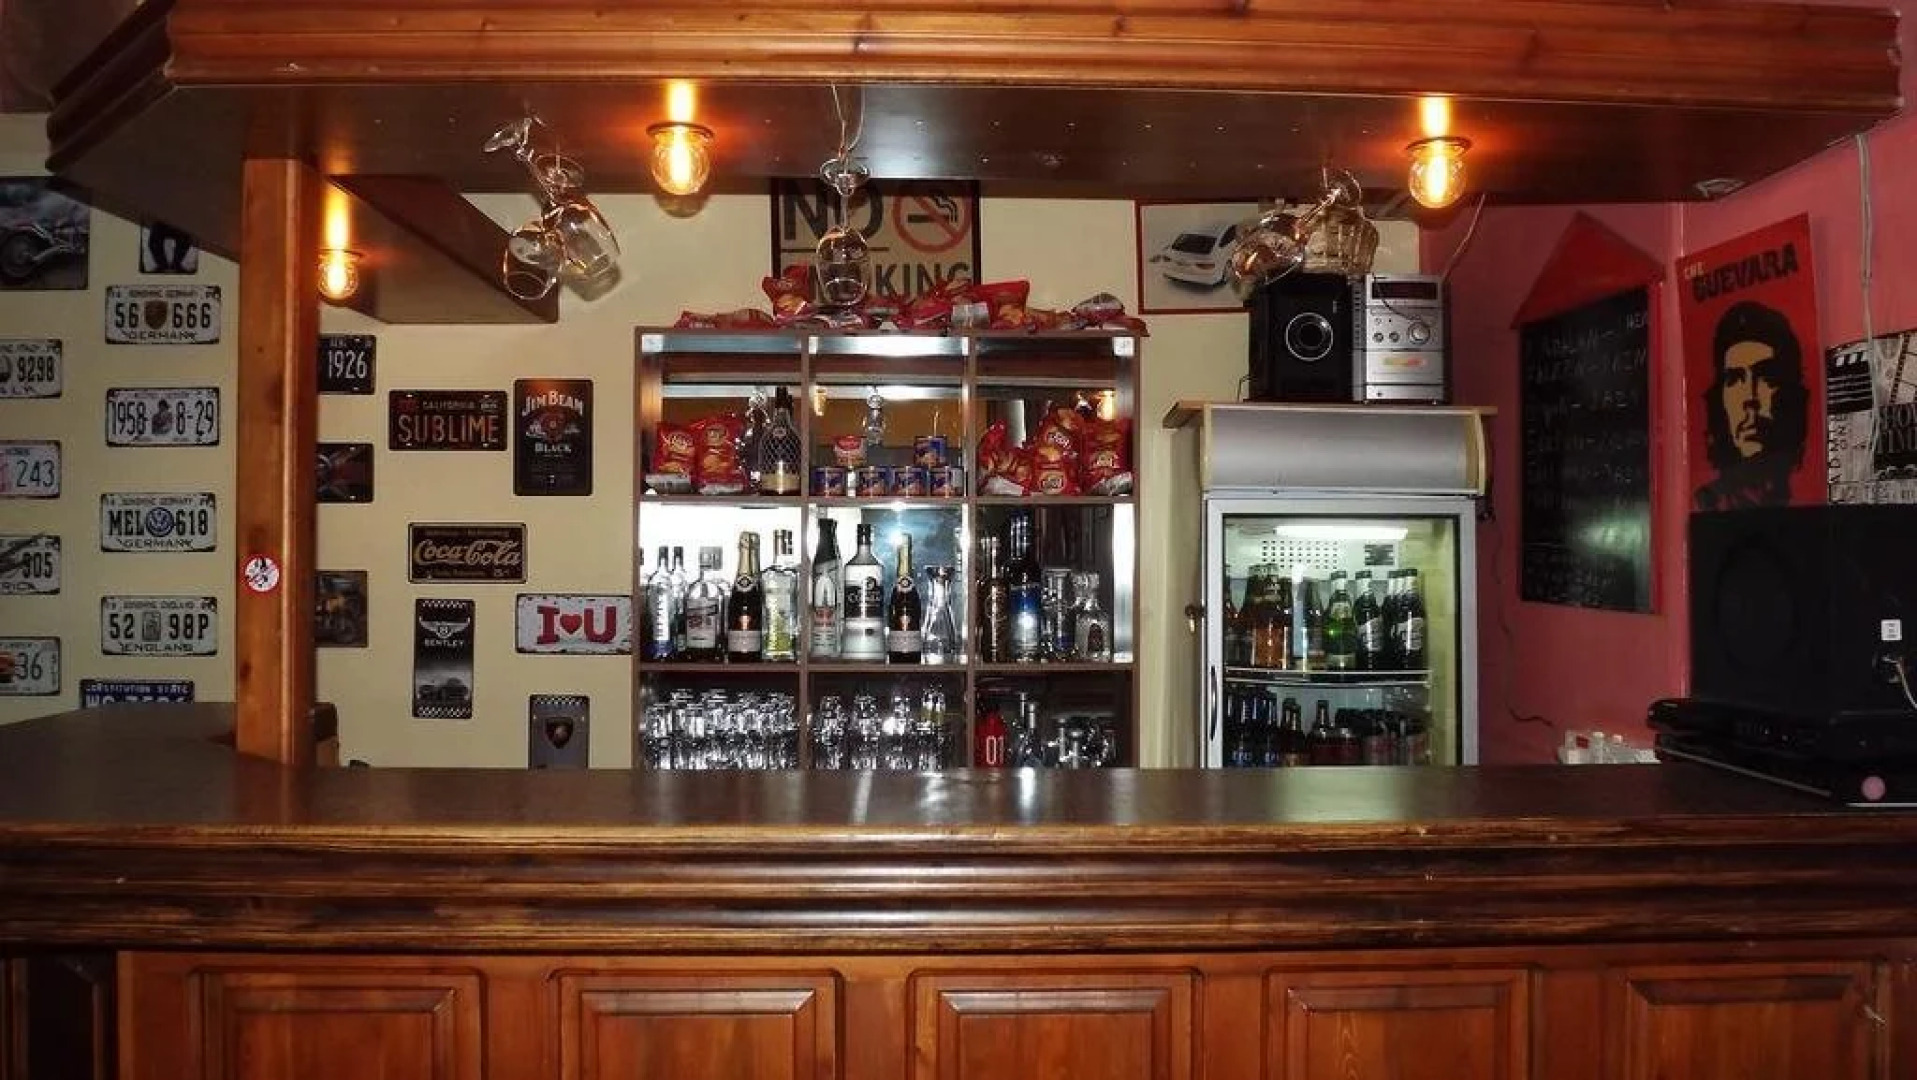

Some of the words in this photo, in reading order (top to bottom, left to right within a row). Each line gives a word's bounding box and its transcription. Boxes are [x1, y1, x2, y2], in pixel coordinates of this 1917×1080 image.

[1692, 243, 1798, 303] GUEVARA
[115, 303, 139, 329] 56
[173, 303, 211, 329] 666
[17, 356, 55, 382] 9298
[326, 350, 368, 379] 1926
[521, 394, 547, 417] JIM
[548, 390, 583, 416] BEAM
[175, 400, 214, 436] 8-29
[398, 414, 499, 443] SUBLIME
[534, 442, 572, 452] BLACK
[17, 460, 55, 487] 243
[108, 510, 145, 536] MEL
[175, 509, 208, 536] 618
[121, 539, 194, 549] GERMANY
[415, 539, 521, 567] Coca-Cola
[109, 613, 135, 639] 52
[168, 613, 209, 639] 98P
[536, 606, 560, 645] I
[583, 606, 617, 645] U
[424, 639, 465, 647] BENTLEY
[15, 653, 43, 680] 36
